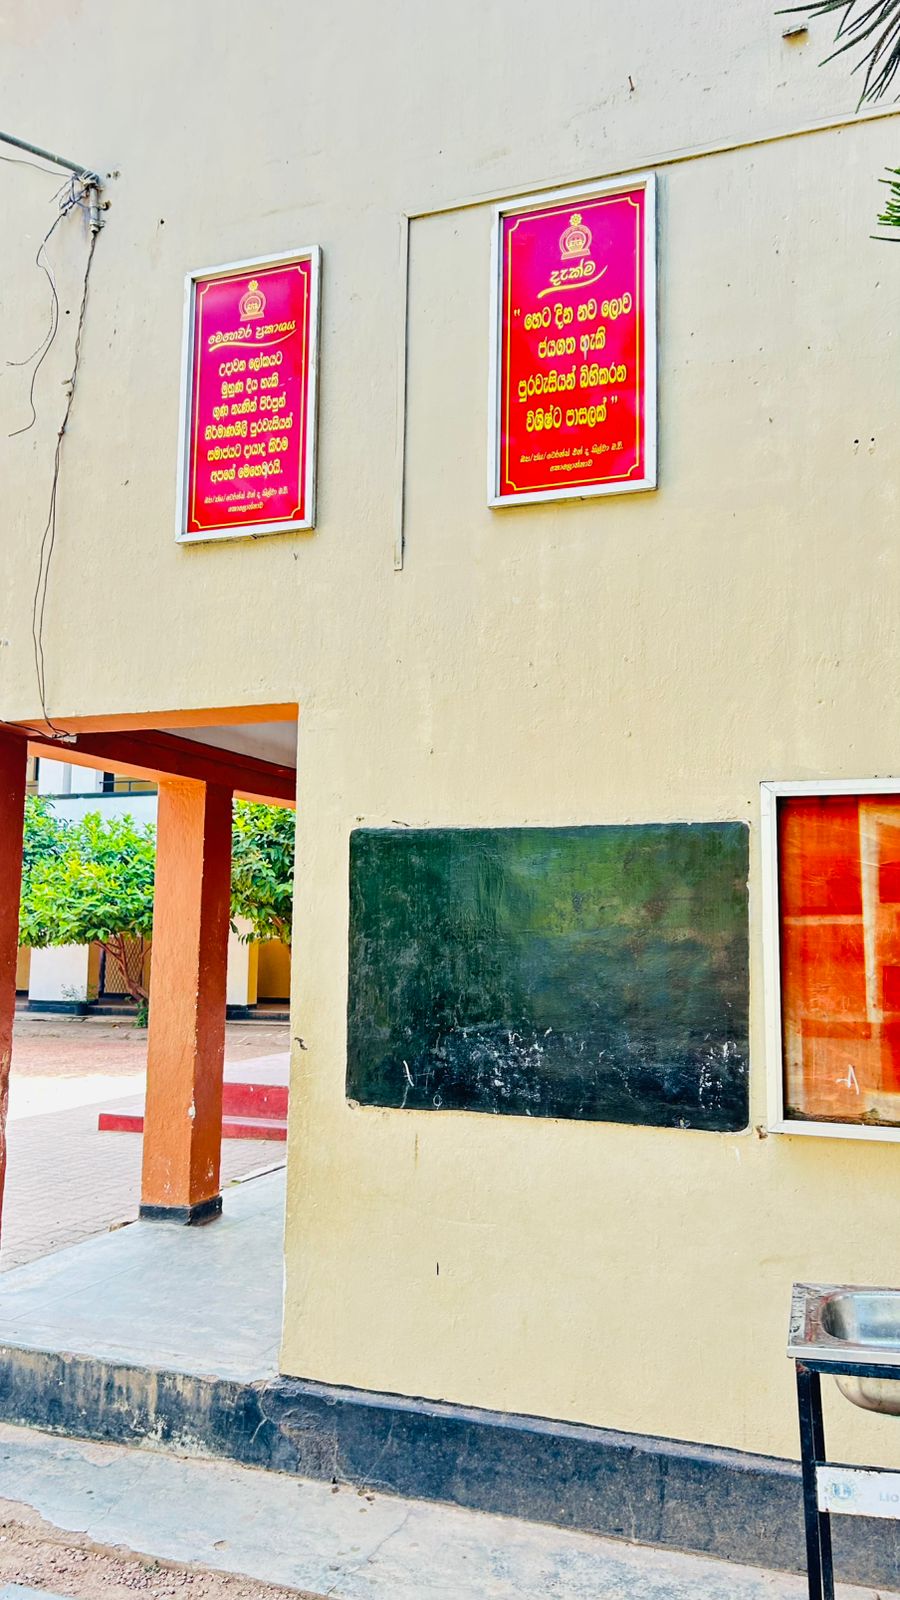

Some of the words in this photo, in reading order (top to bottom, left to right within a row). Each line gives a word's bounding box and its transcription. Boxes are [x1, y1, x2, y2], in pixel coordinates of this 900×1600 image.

[549, 258, 596, 286] දැක්ම
[524, 306, 552, 330] හෙට
[577, 298, 597, 321] නව
